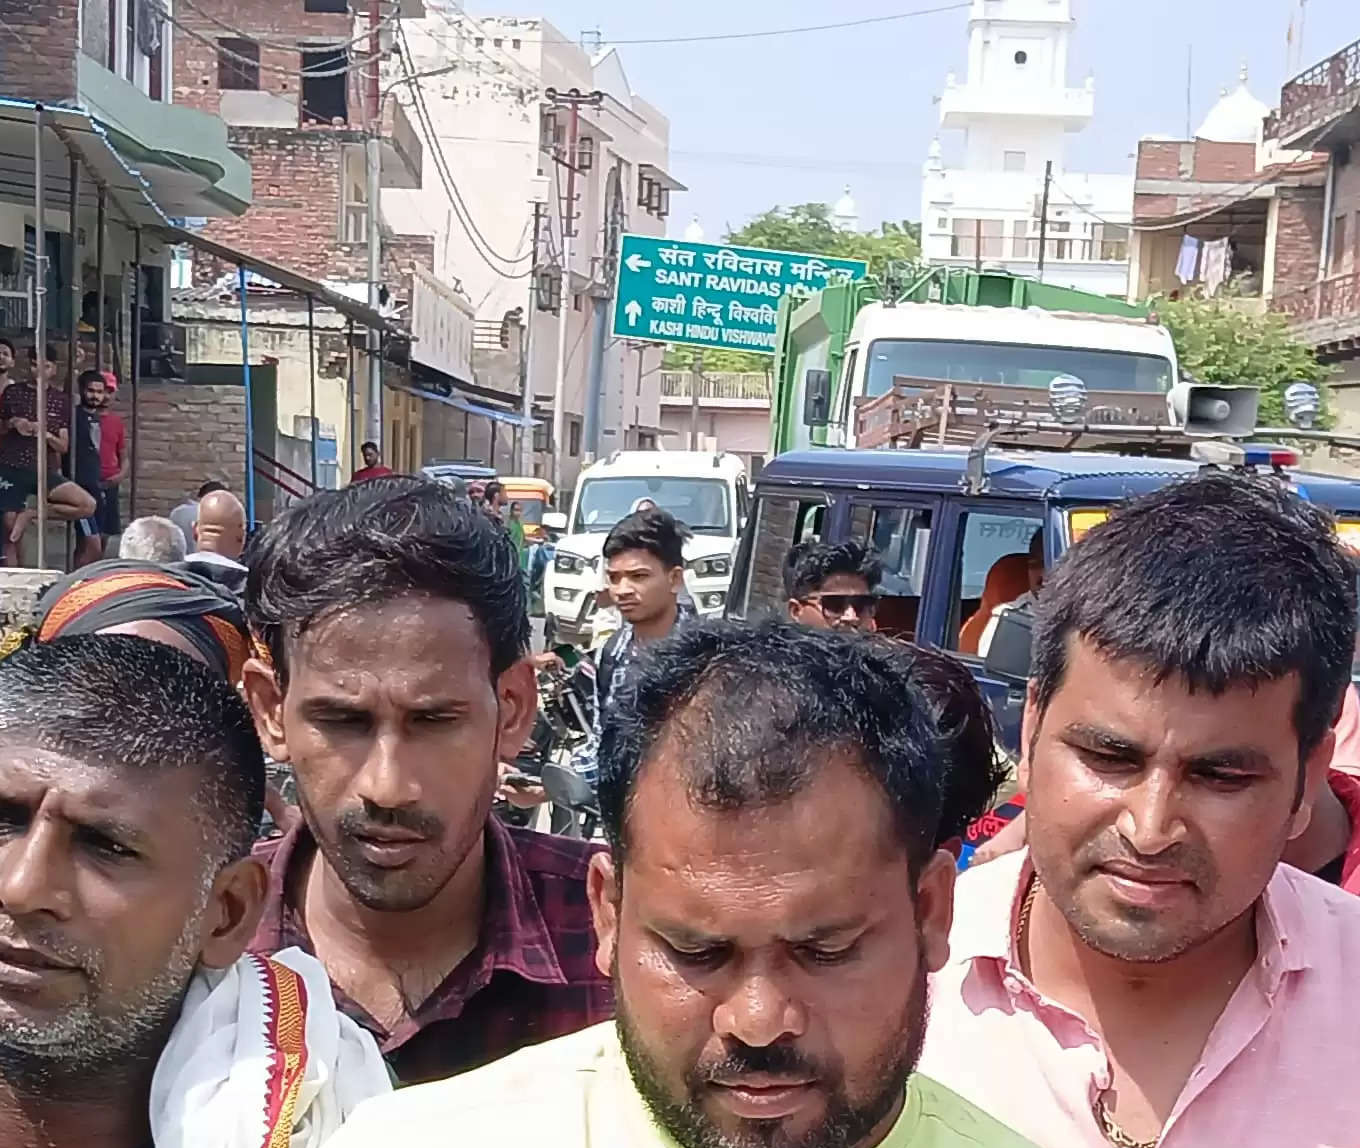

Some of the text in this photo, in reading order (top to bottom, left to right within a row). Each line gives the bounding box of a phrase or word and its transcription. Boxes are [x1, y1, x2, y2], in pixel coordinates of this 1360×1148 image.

[658, 245, 696, 267] संत
[703, 250, 783, 278] रविदास
[655, 269, 702, 289] SANT
[706, 275, 781, 297] RAVIDAS
[652, 293, 686, 316] काशी
[692, 296, 723, 325] हिन्दू
[650, 319, 683, 337] KASHI
[685, 323, 719, 341] HINDU
